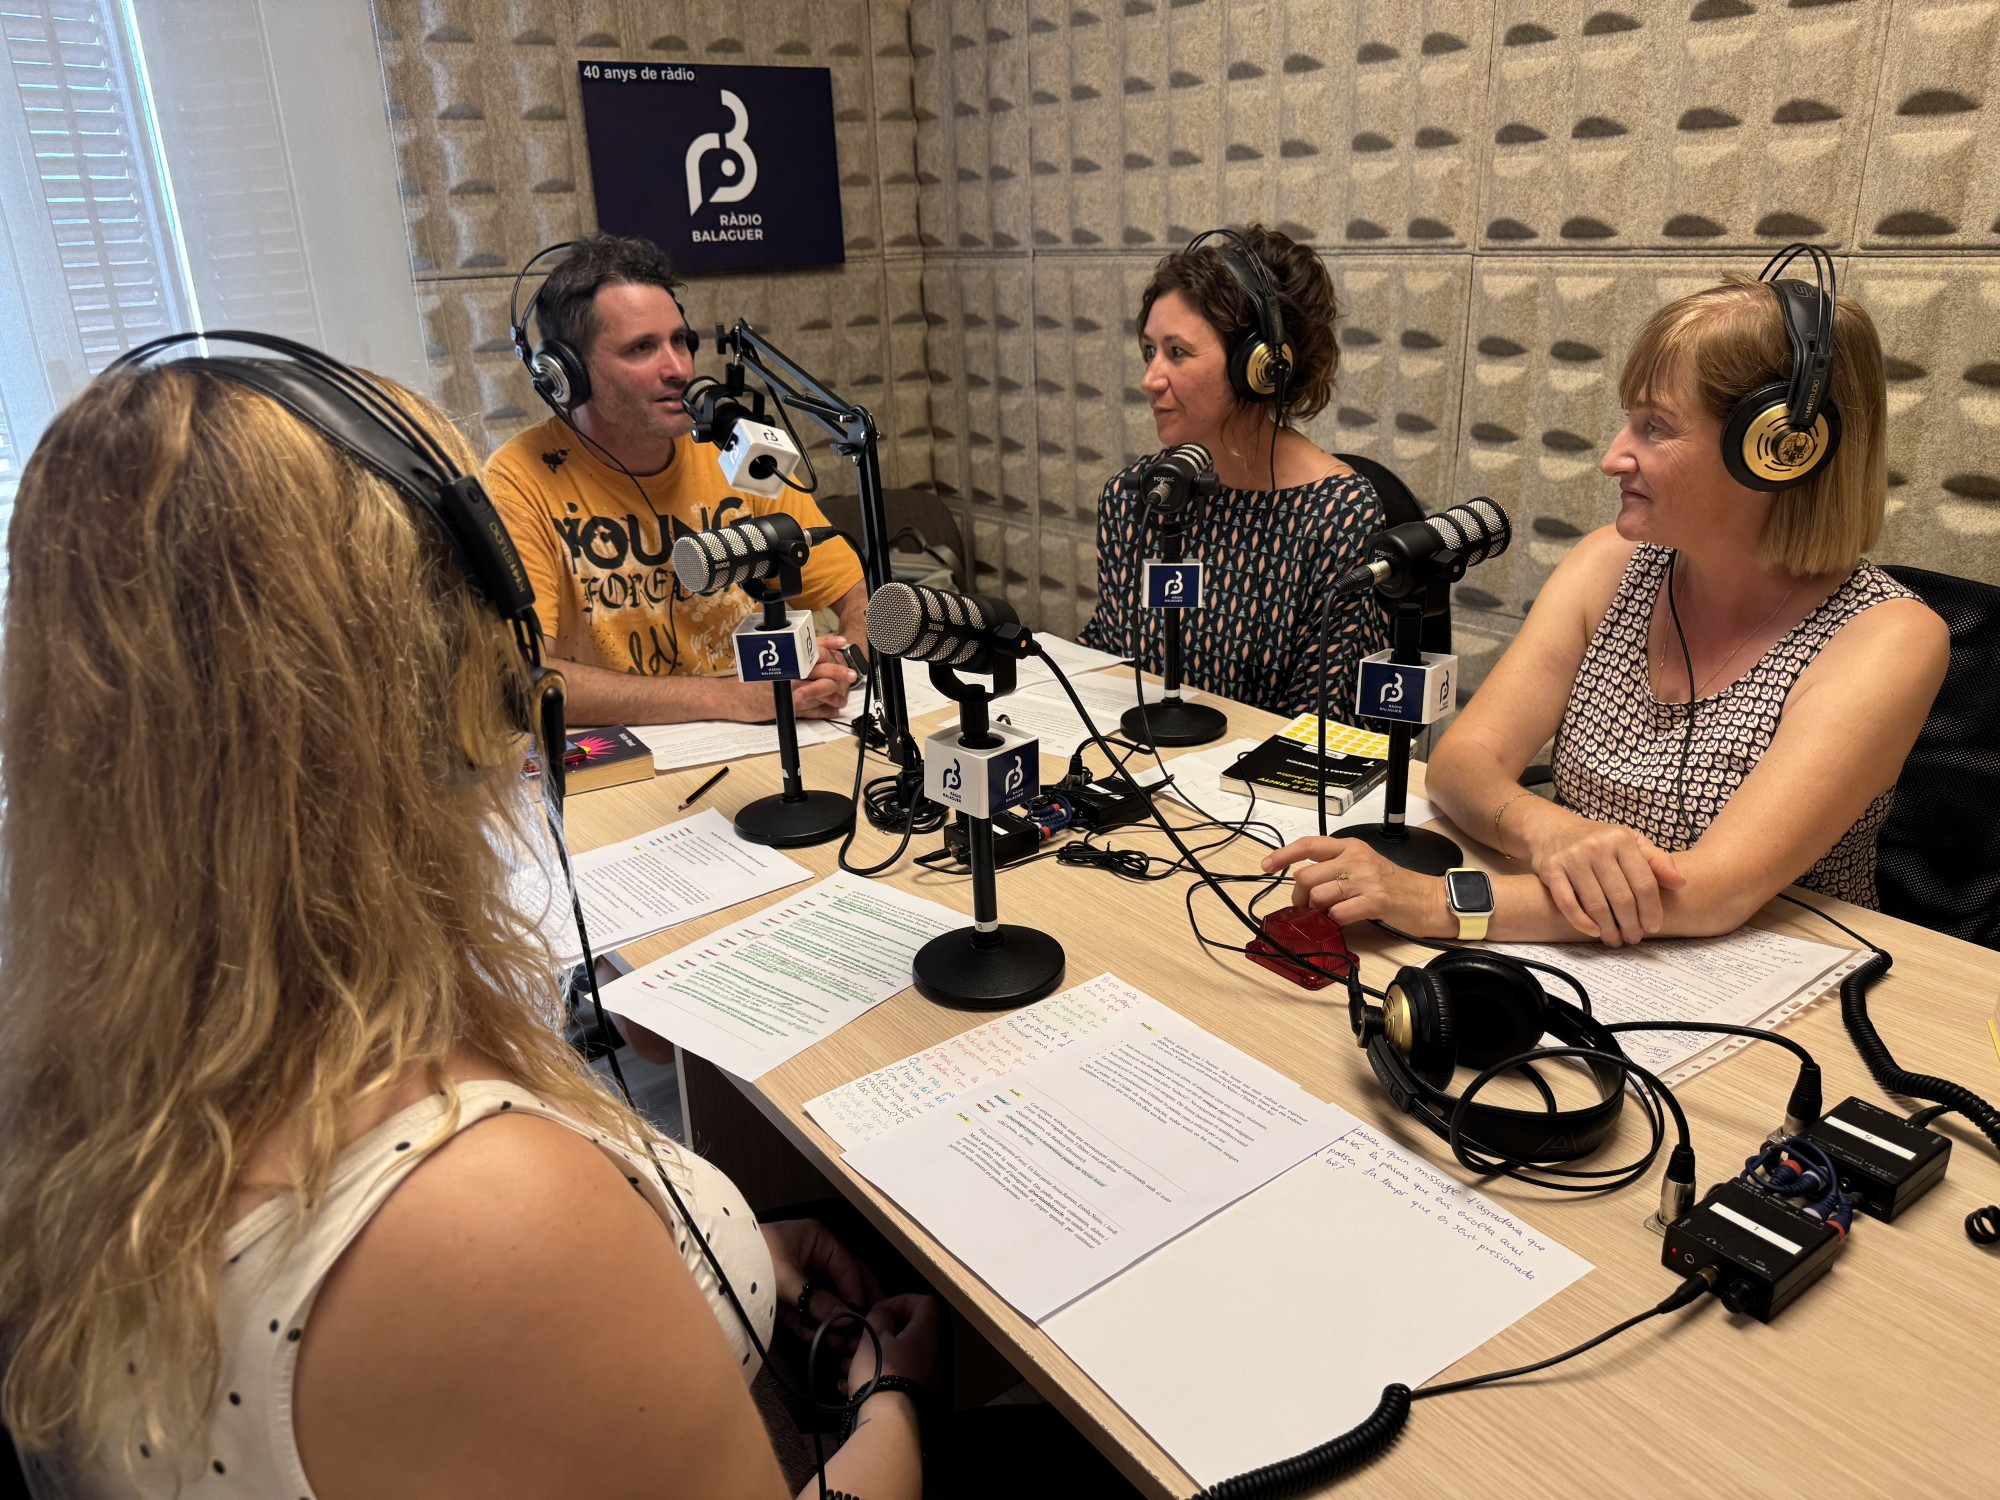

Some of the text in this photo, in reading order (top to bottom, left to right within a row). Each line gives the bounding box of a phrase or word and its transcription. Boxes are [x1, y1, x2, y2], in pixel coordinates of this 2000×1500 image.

[583, 65, 695, 83] 40 anys de ràdio
[692, 229, 763, 243] BALAGUER
[720, 212, 762, 226] RÀDIO
[1368, 1150, 1378, 1161] la
[1379, 1160, 1410, 1183] persona
[1412, 1183, 1430, 1198] que
[1435, 1196, 1453, 1211] ens
[1457, 1209, 1496, 1238] escolta
[1386, 1149, 1409, 1166] quin
[1414, 1166, 1462, 1198] missatge
[1527, 1237, 1547, 1254] que
[1362, 1166, 1377, 1181] fa
[1411, 1199, 1432, 1216] que
[1476, 1241, 1537, 1283] presionada
